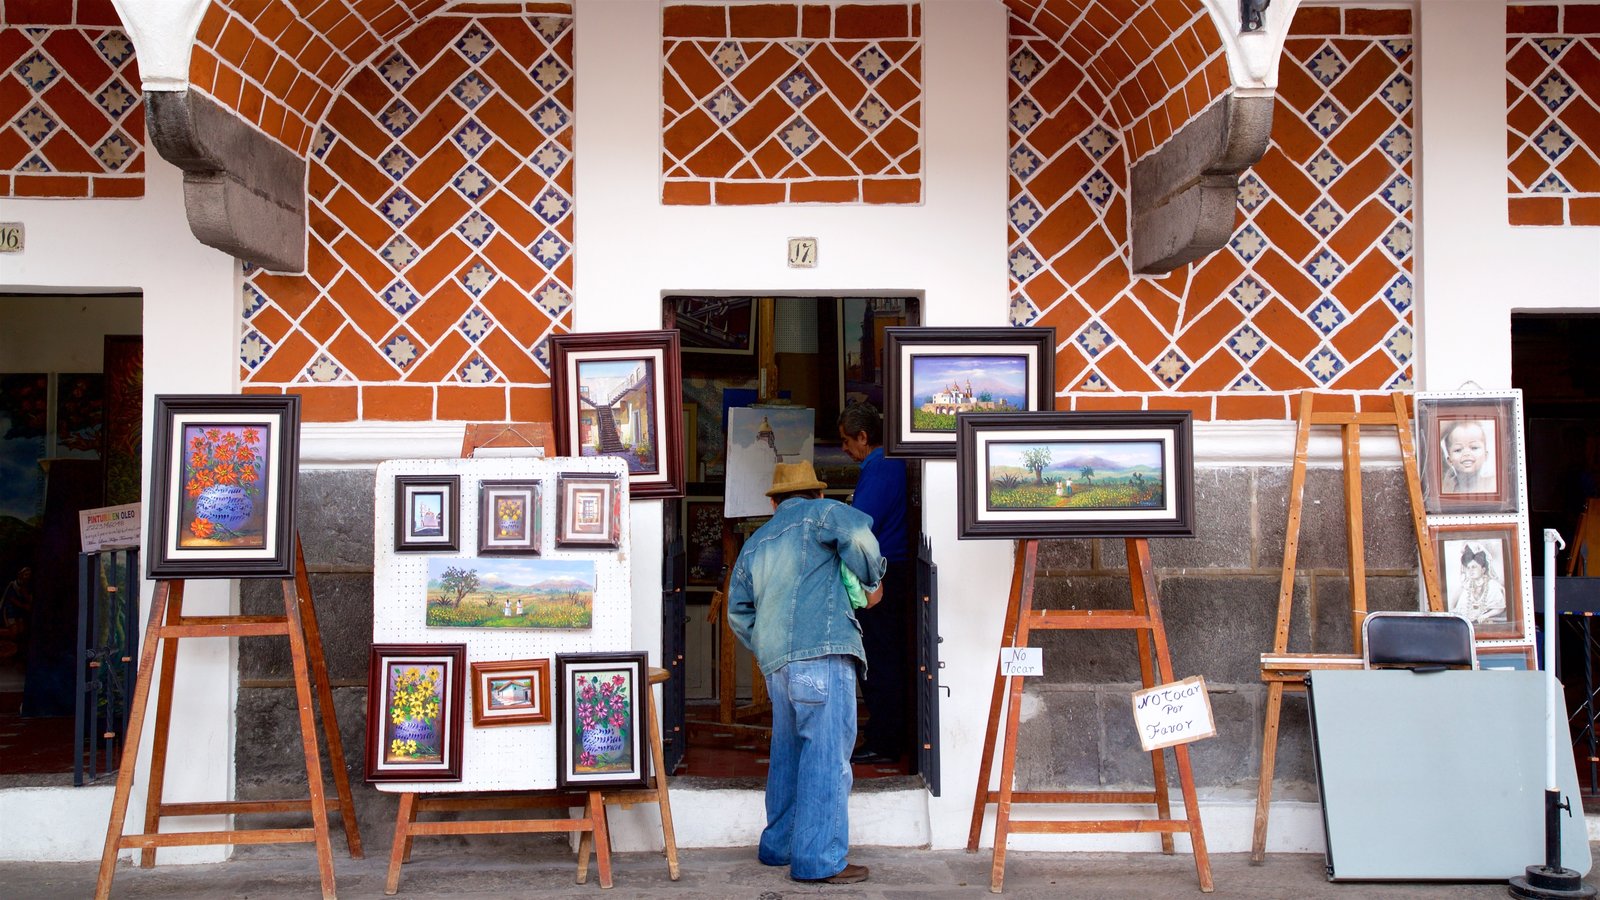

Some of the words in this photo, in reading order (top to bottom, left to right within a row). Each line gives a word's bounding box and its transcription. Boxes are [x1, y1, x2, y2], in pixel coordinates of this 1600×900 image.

[112, 512, 119, 520] EN
[121, 510, 135, 520] OLEO
[1004, 661, 1034, 673] Tocar
[1162, 704, 1184, 715] Por
[1146, 720, 1193, 740] Favor
